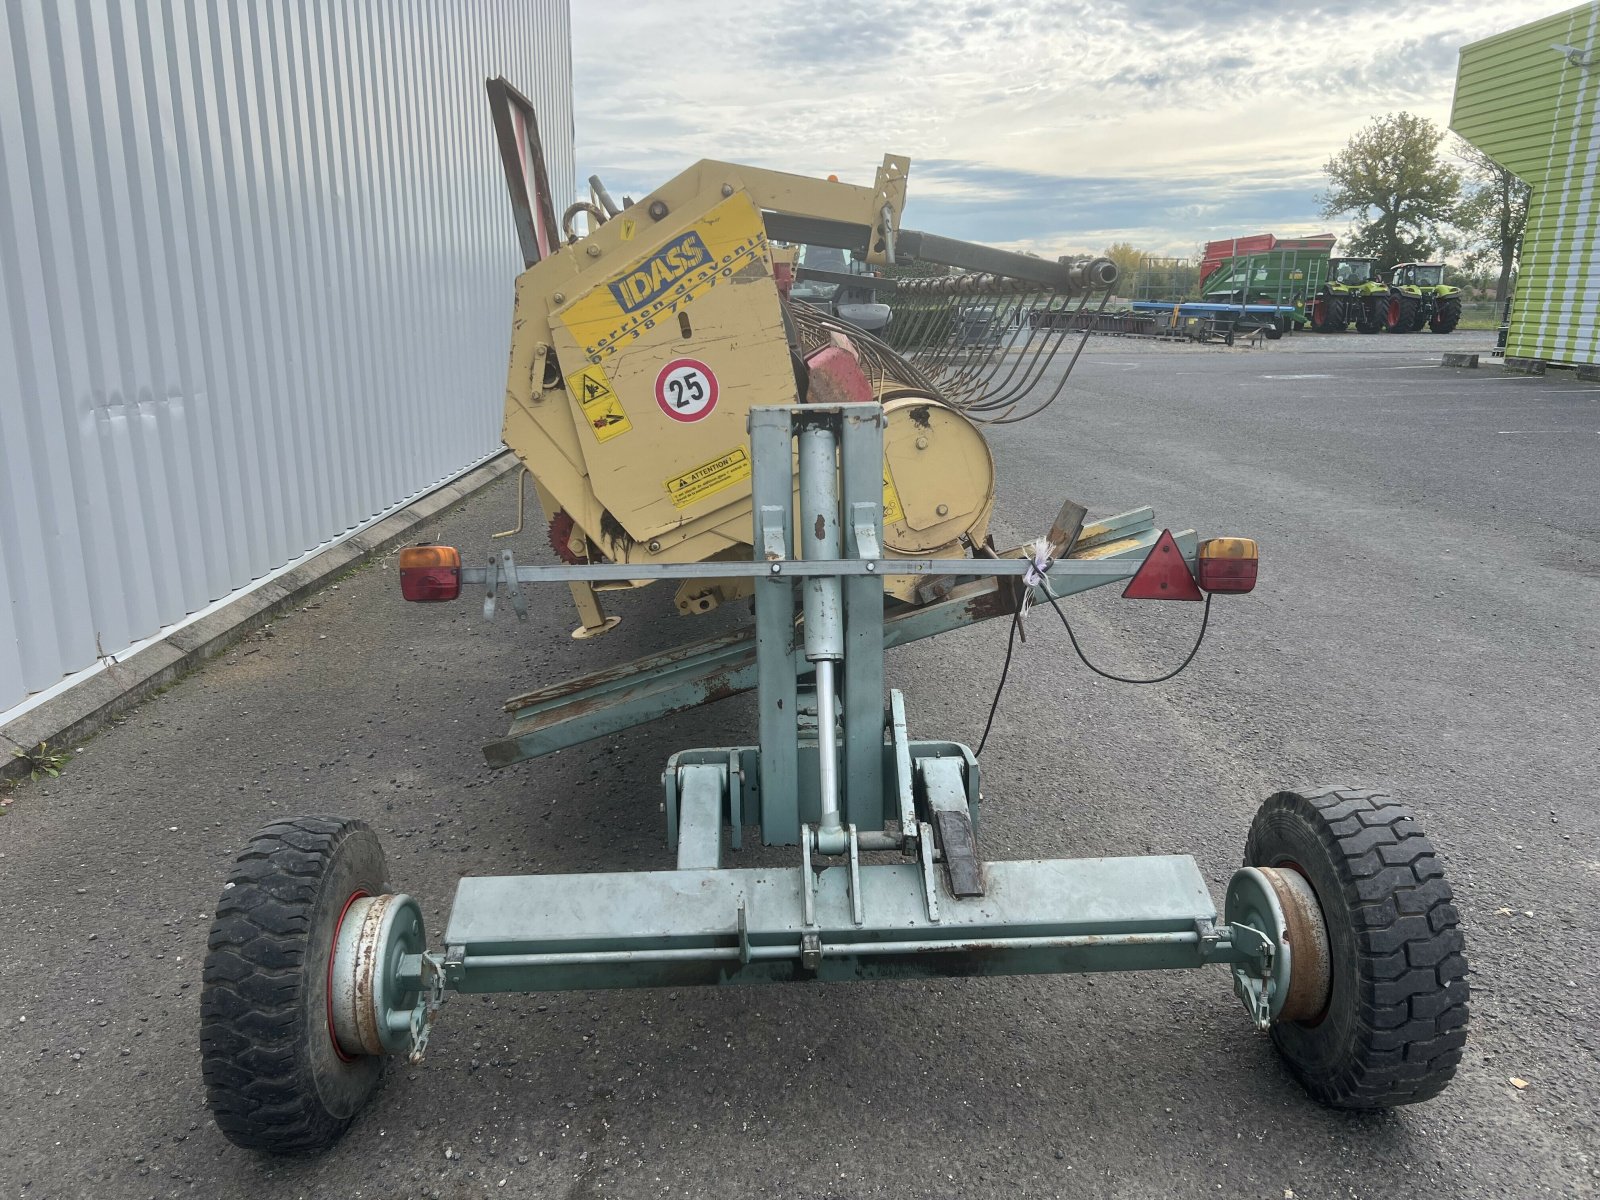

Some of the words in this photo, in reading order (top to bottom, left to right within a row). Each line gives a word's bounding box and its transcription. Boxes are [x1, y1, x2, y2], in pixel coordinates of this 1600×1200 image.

[586, 300, 664, 354] terrien
[674, 231, 764, 295] d'avenir
[618, 236, 703, 309] IDASS
[630, 319, 656, 340] 38
[668, 293, 694, 314] 74
[706, 267, 733, 288] 70
[669, 372, 704, 409] 25
[691, 459, 729, 480] ATTENTION
